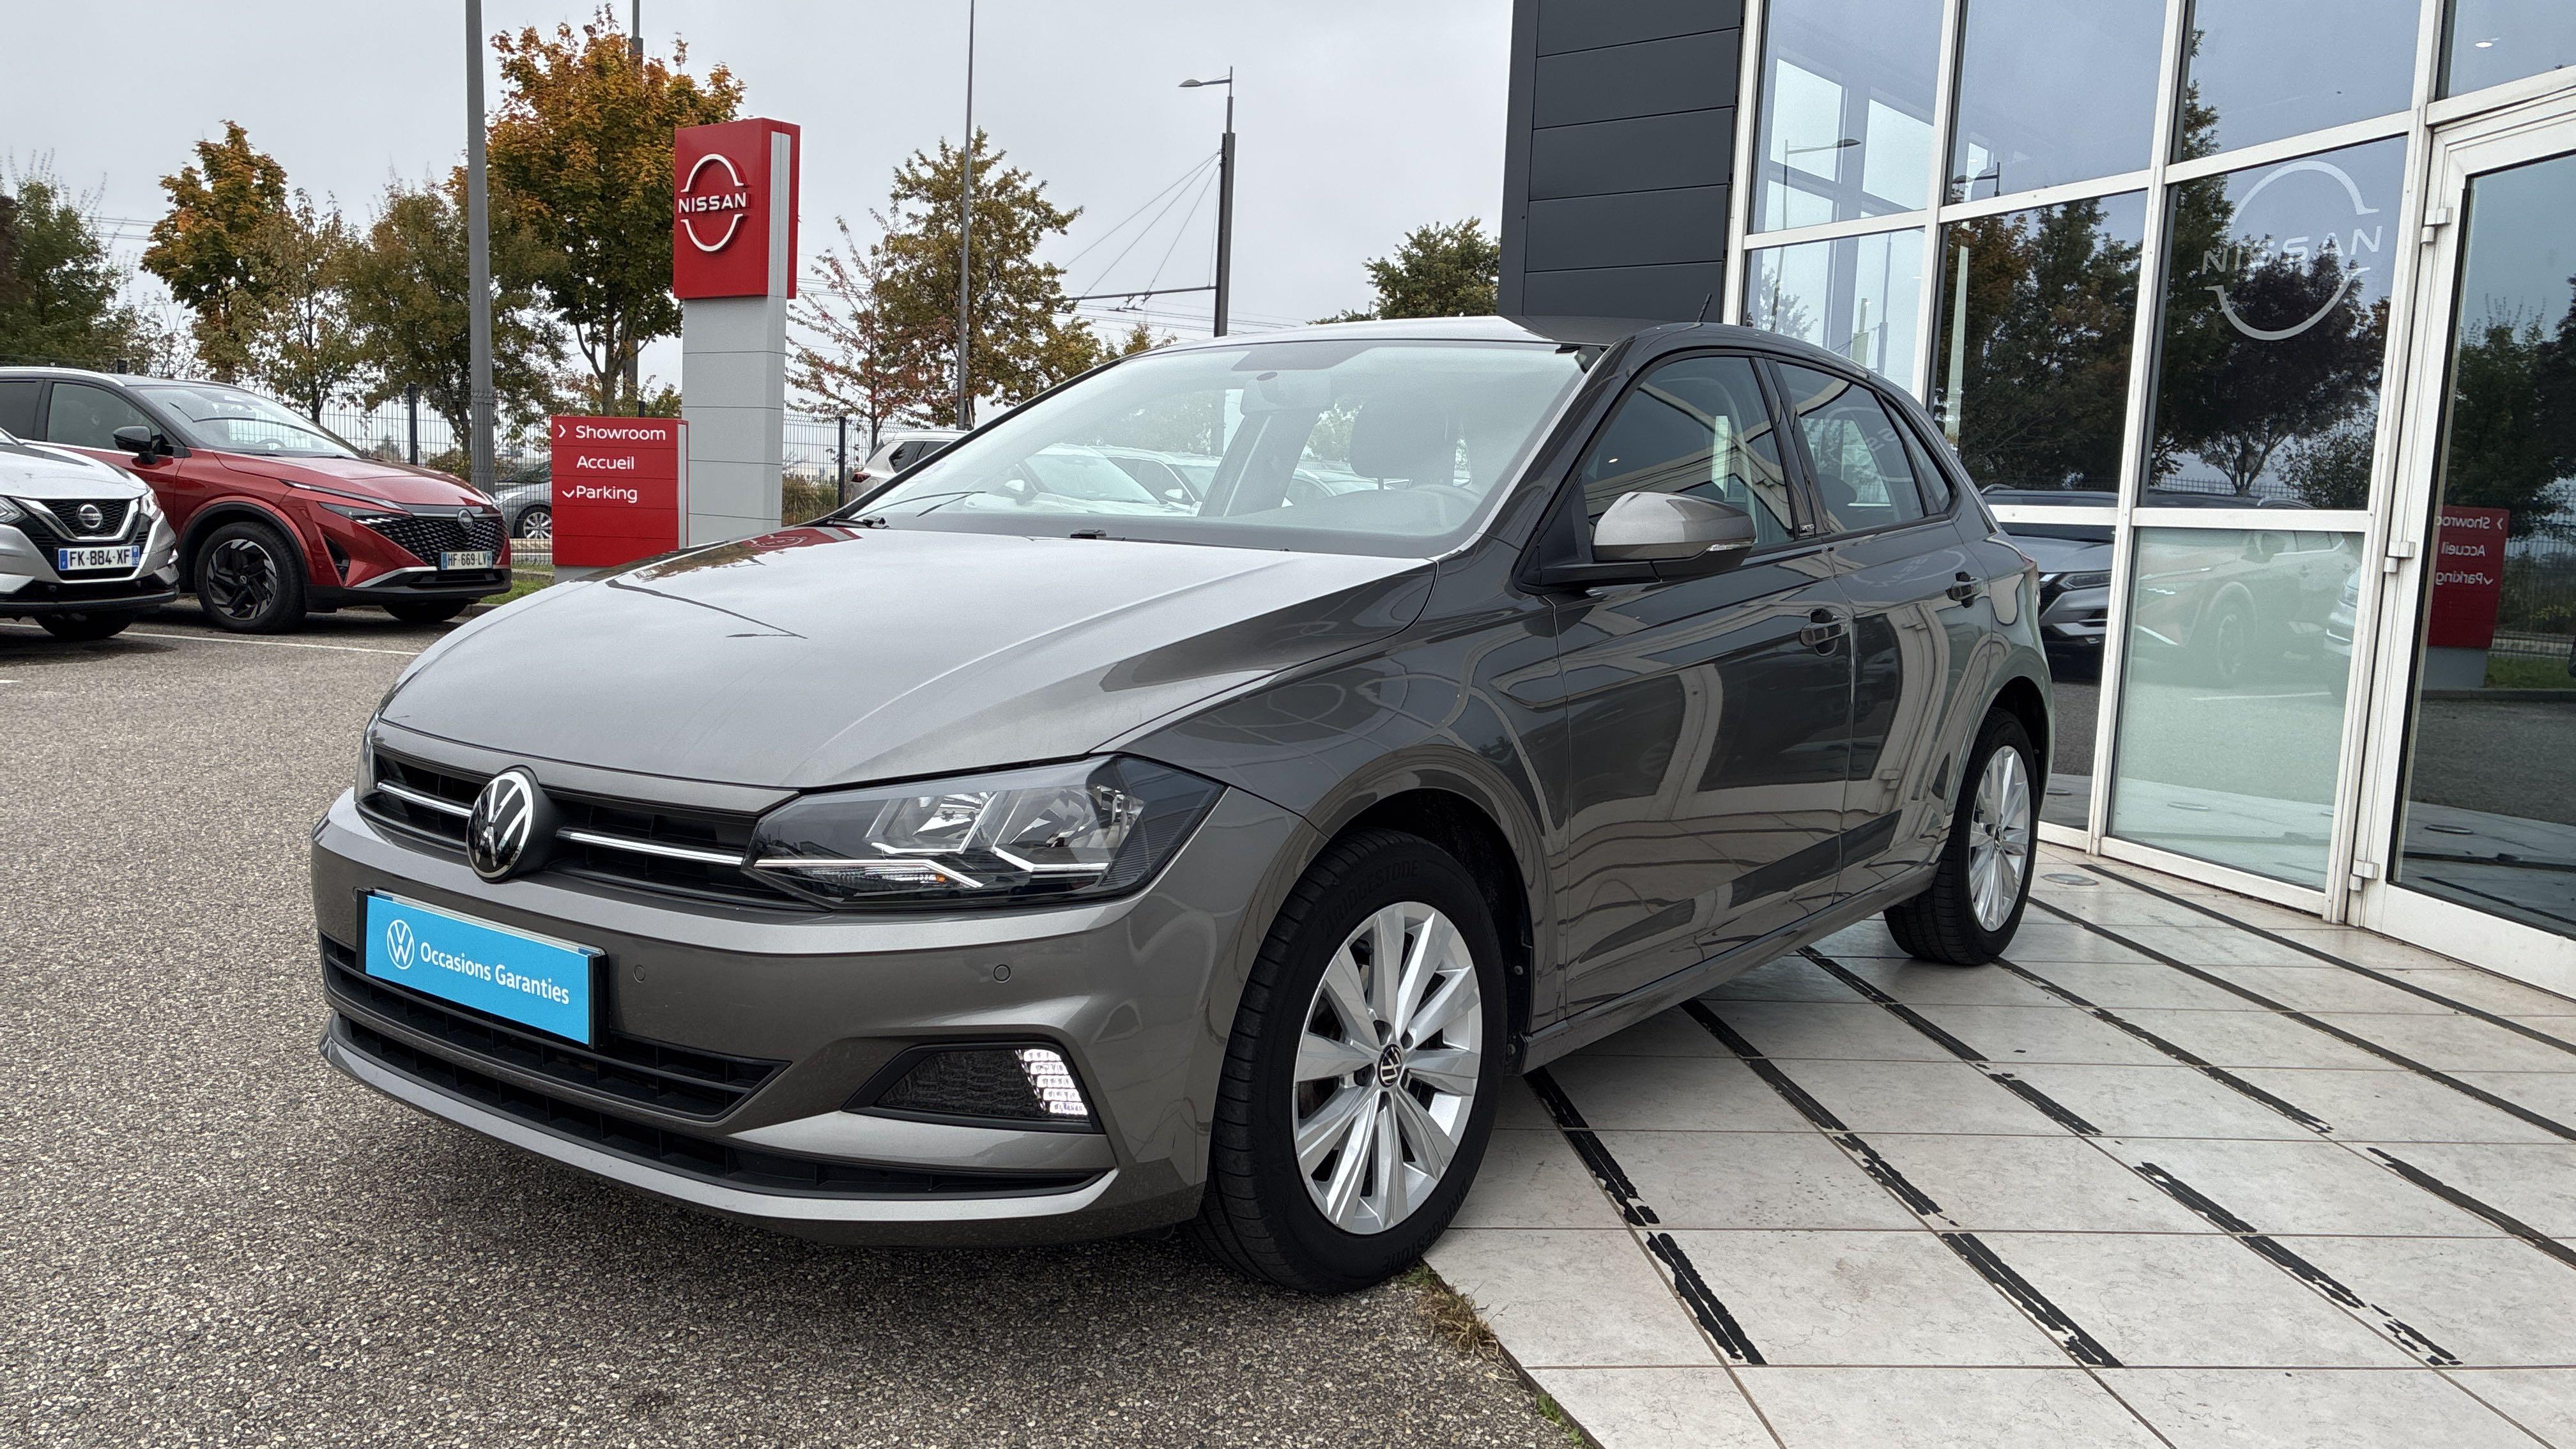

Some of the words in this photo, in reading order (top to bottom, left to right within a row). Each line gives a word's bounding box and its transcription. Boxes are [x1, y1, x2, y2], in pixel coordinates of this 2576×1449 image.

[678, 192, 746, 213] NISSAN
[2202, 225, 2383, 275] NISSAN
[576, 425, 666, 441] Showroom
[576, 456, 634, 470] Accueil
[576, 486, 638, 503] Parking
[420, 942, 491, 981] Occasions
[494, 964, 569, 1005] Garanties
